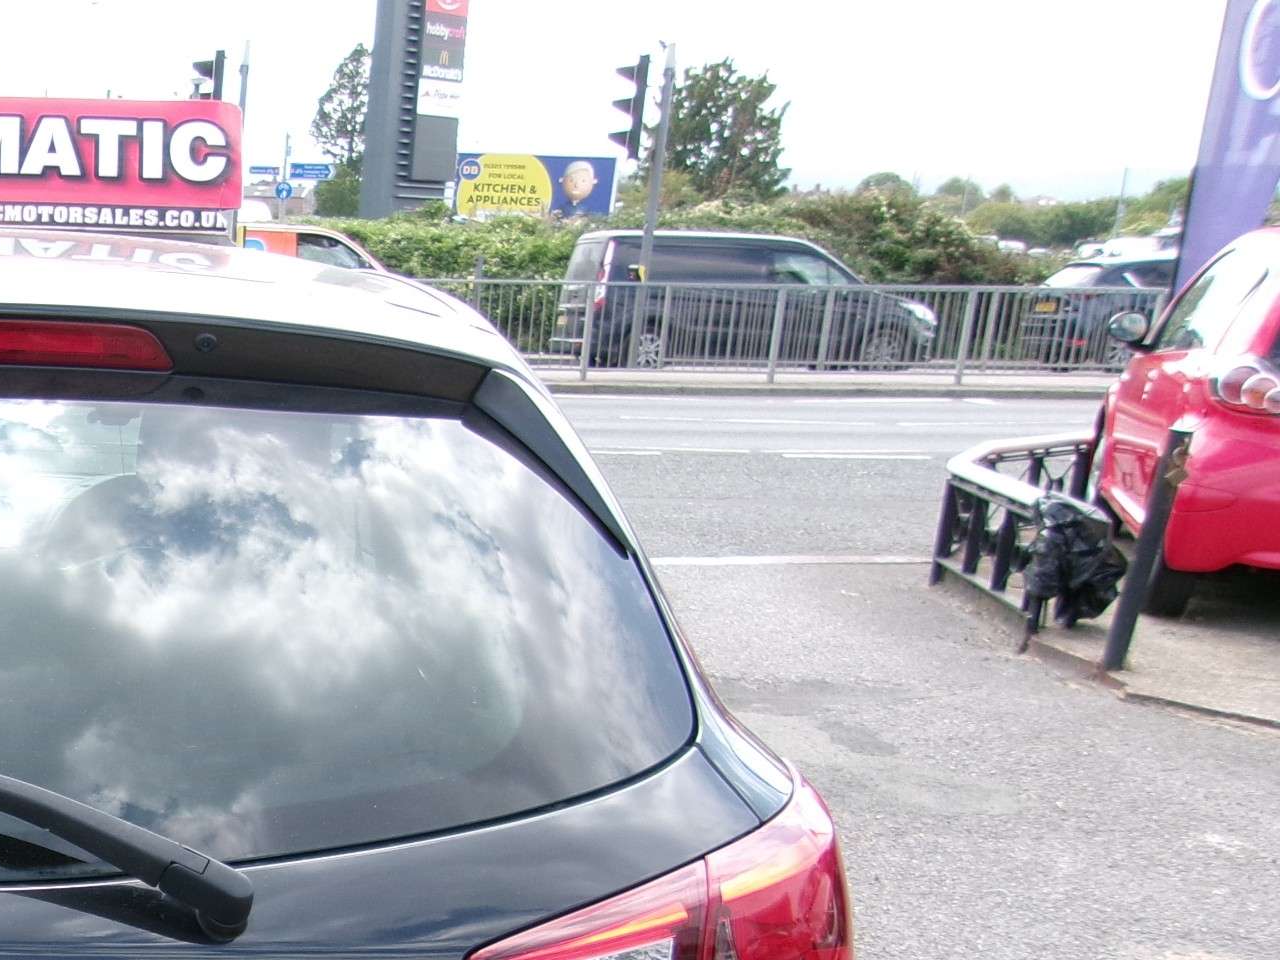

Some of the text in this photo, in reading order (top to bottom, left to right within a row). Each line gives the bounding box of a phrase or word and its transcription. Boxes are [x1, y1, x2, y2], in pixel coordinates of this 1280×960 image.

[473, 183, 537, 194] KITCHEN &
[466, 195, 541, 207] APPLIANCES
